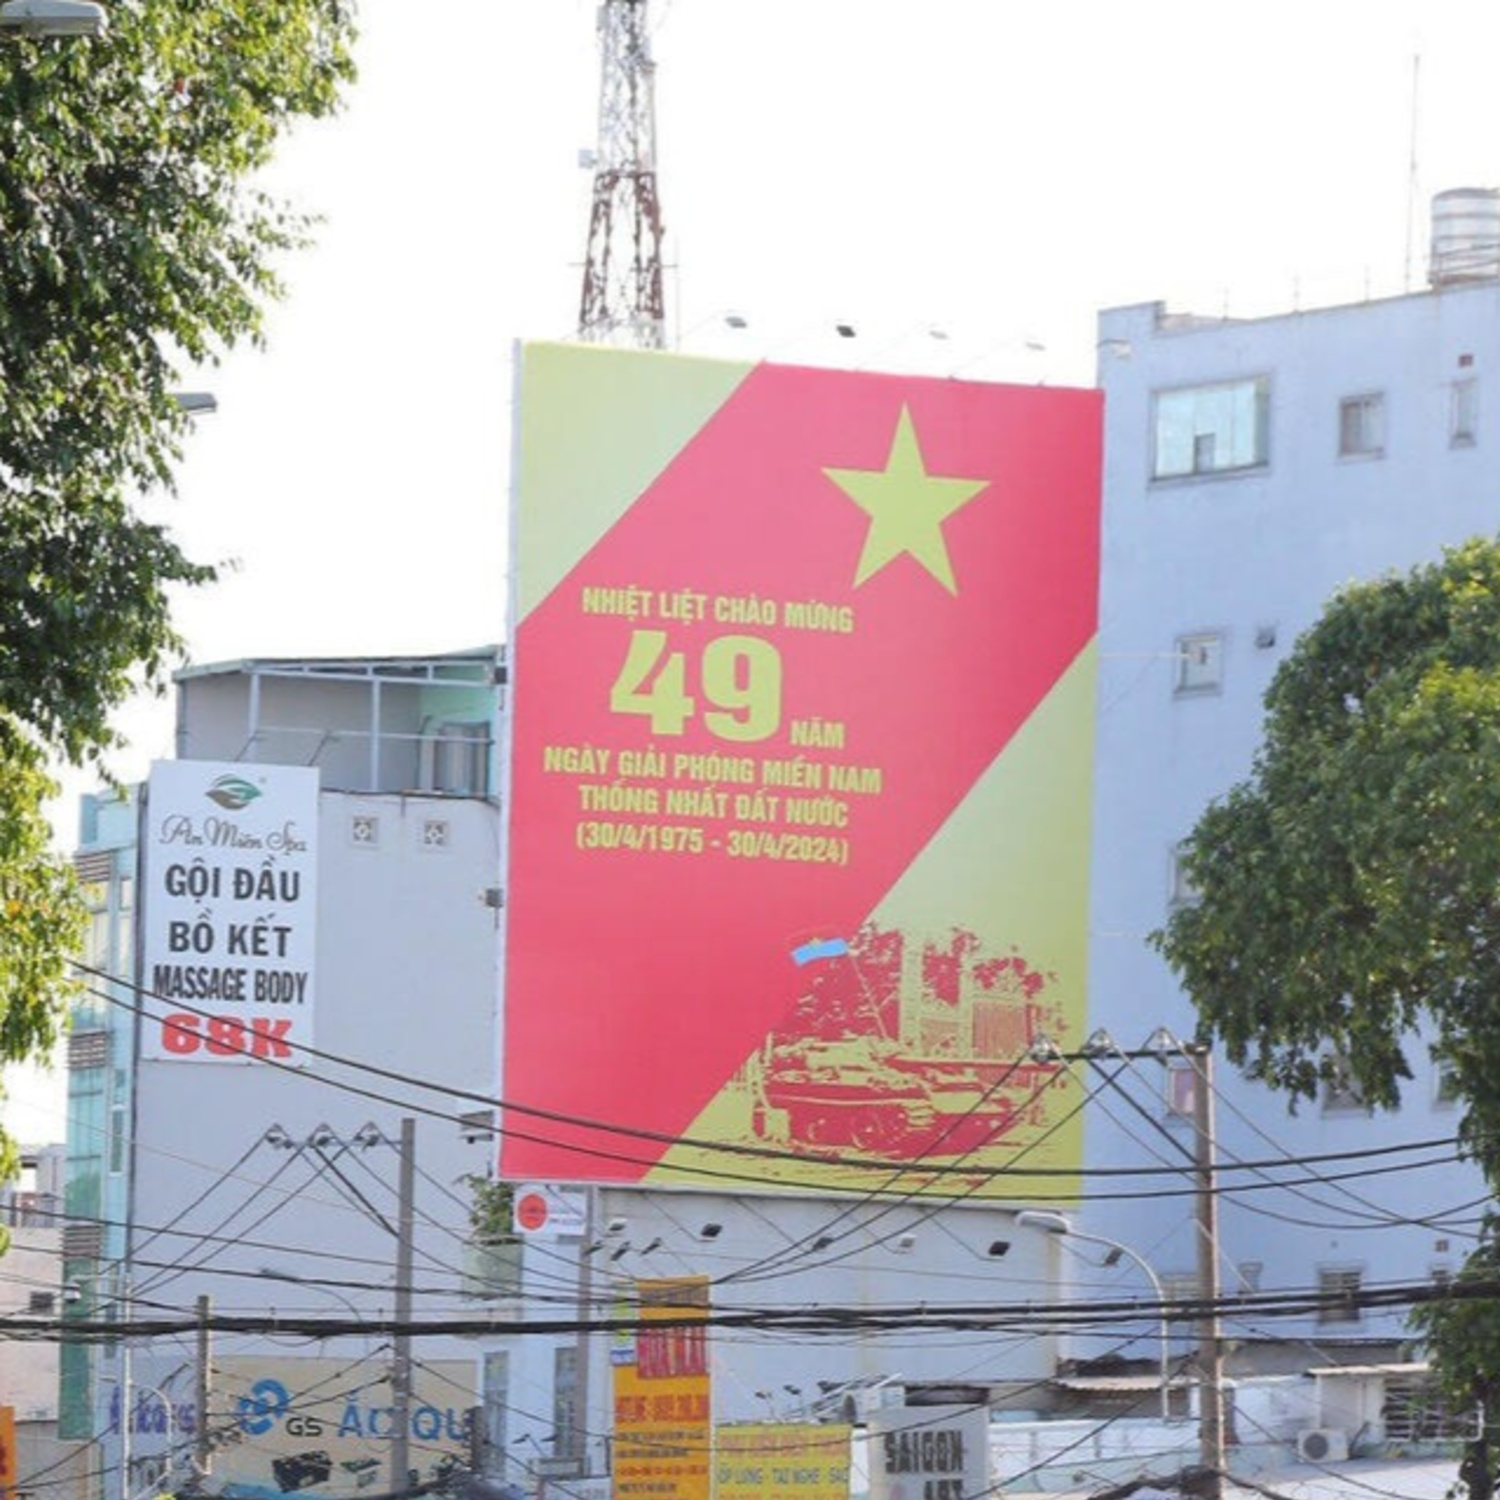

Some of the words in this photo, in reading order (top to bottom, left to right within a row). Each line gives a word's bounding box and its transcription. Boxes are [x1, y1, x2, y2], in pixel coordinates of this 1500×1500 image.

[583, 585, 652, 622] NHIỆT
[659, 588, 707, 625] LIỆT
[714, 593, 777, 627] CHÀO
[784, 599, 853, 633] MỪNG
[610, 629, 782, 741] 49
[789, 717, 845, 749] NĂM
[544, 742, 610, 777] NGÀY
[618, 744, 666, 778] GIẢI
[673, 750, 755, 784] PHÓNG
[762, 755, 822, 789] MIỀN
[829, 765, 883, 794] NAM
[578, 778, 659, 814] THỐNG
[665, 784, 728, 819] NHẤT
[735, 787, 778, 822] ĐẤT
[786, 794, 849, 828] NƯỚC
[576, 821, 703, 853] (30/4/1975
[728, 829, 849, 866] 30/4/2024)
[164, 857, 221, 904] GỘI
[232, 854, 300, 902] ĐẦU
[168, 908, 214, 954] BỒ
[228, 912, 292, 958] KẾT
[153, 964, 247, 1003] MASSAGE
[254, 969, 308, 1004] BODY
[161, 1012, 293, 1058] 68K
[286, 1417, 322, 1437] GS
[883, 1430, 963, 1474] SAIGON
